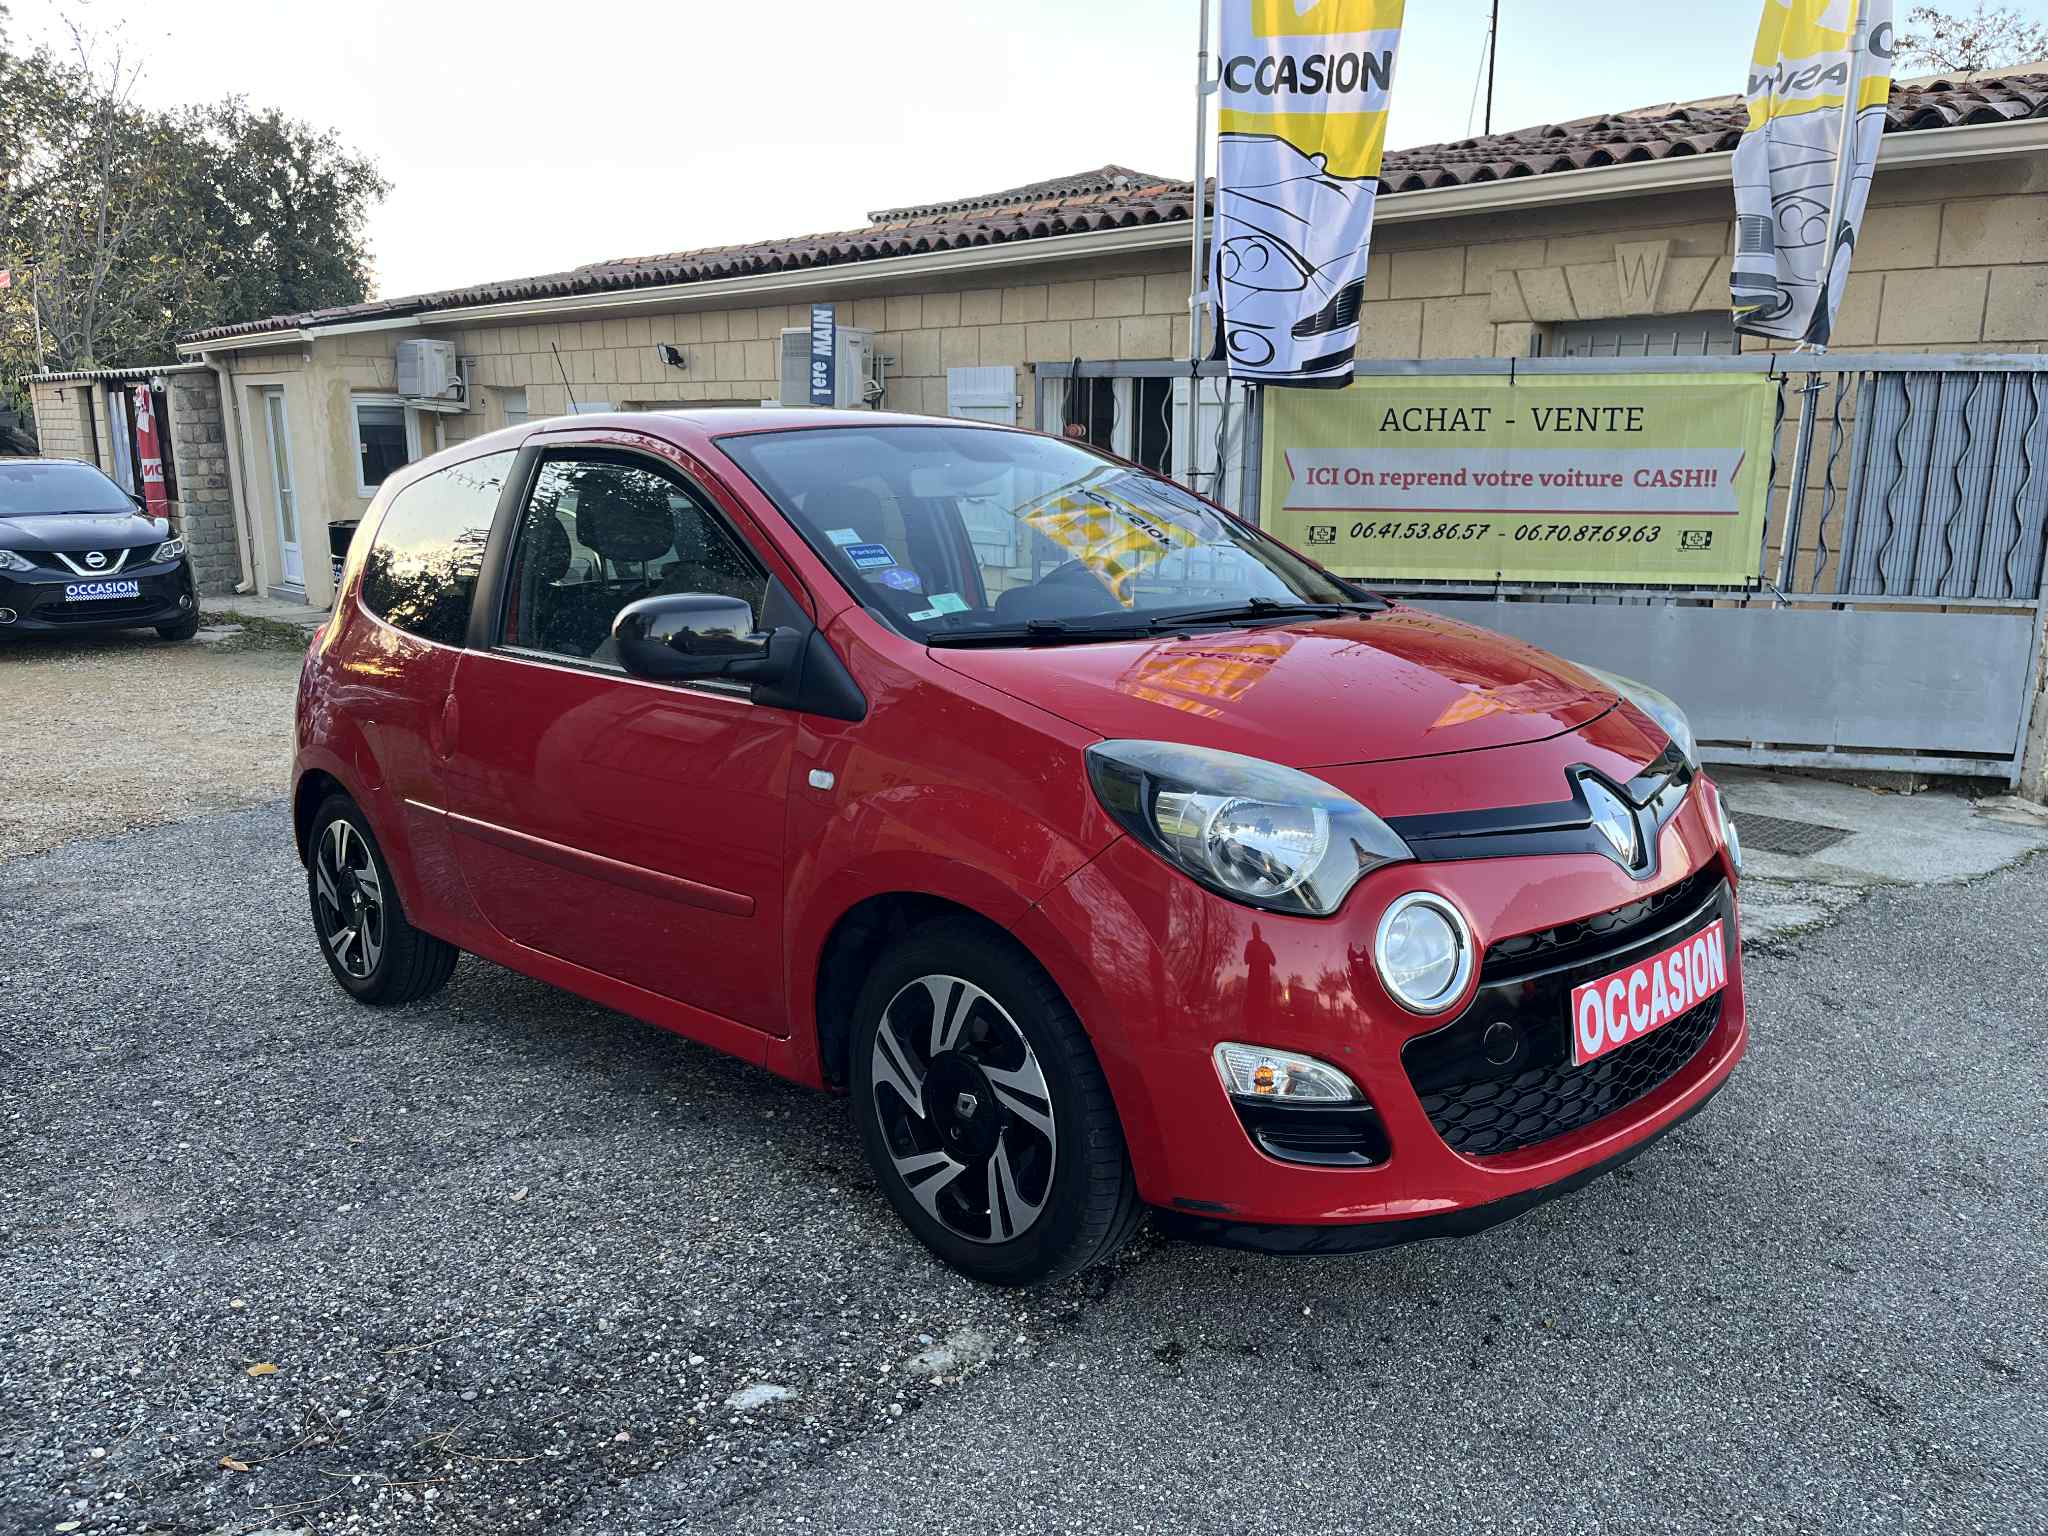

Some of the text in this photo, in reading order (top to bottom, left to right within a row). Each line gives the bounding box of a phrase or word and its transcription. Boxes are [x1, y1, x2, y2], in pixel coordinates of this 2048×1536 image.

[1217, 50, 1393, 96] CCASION
[812, 309, 832, 357] MAIN
[1378, 407, 1491, 432] ACHAT
[1531, 407, 1644, 432] VENTE
[1306, 468, 1718, 490] ICI On reprend votre voiture CASH!!
[1350, 522, 1491, 540] 06.41.53.86.57
[1514, 524, 1661, 543] 06.70.87.69.63
[66, 581, 139, 596] OCCASION
[1579, 928, 1725, 1054] OCCASION
